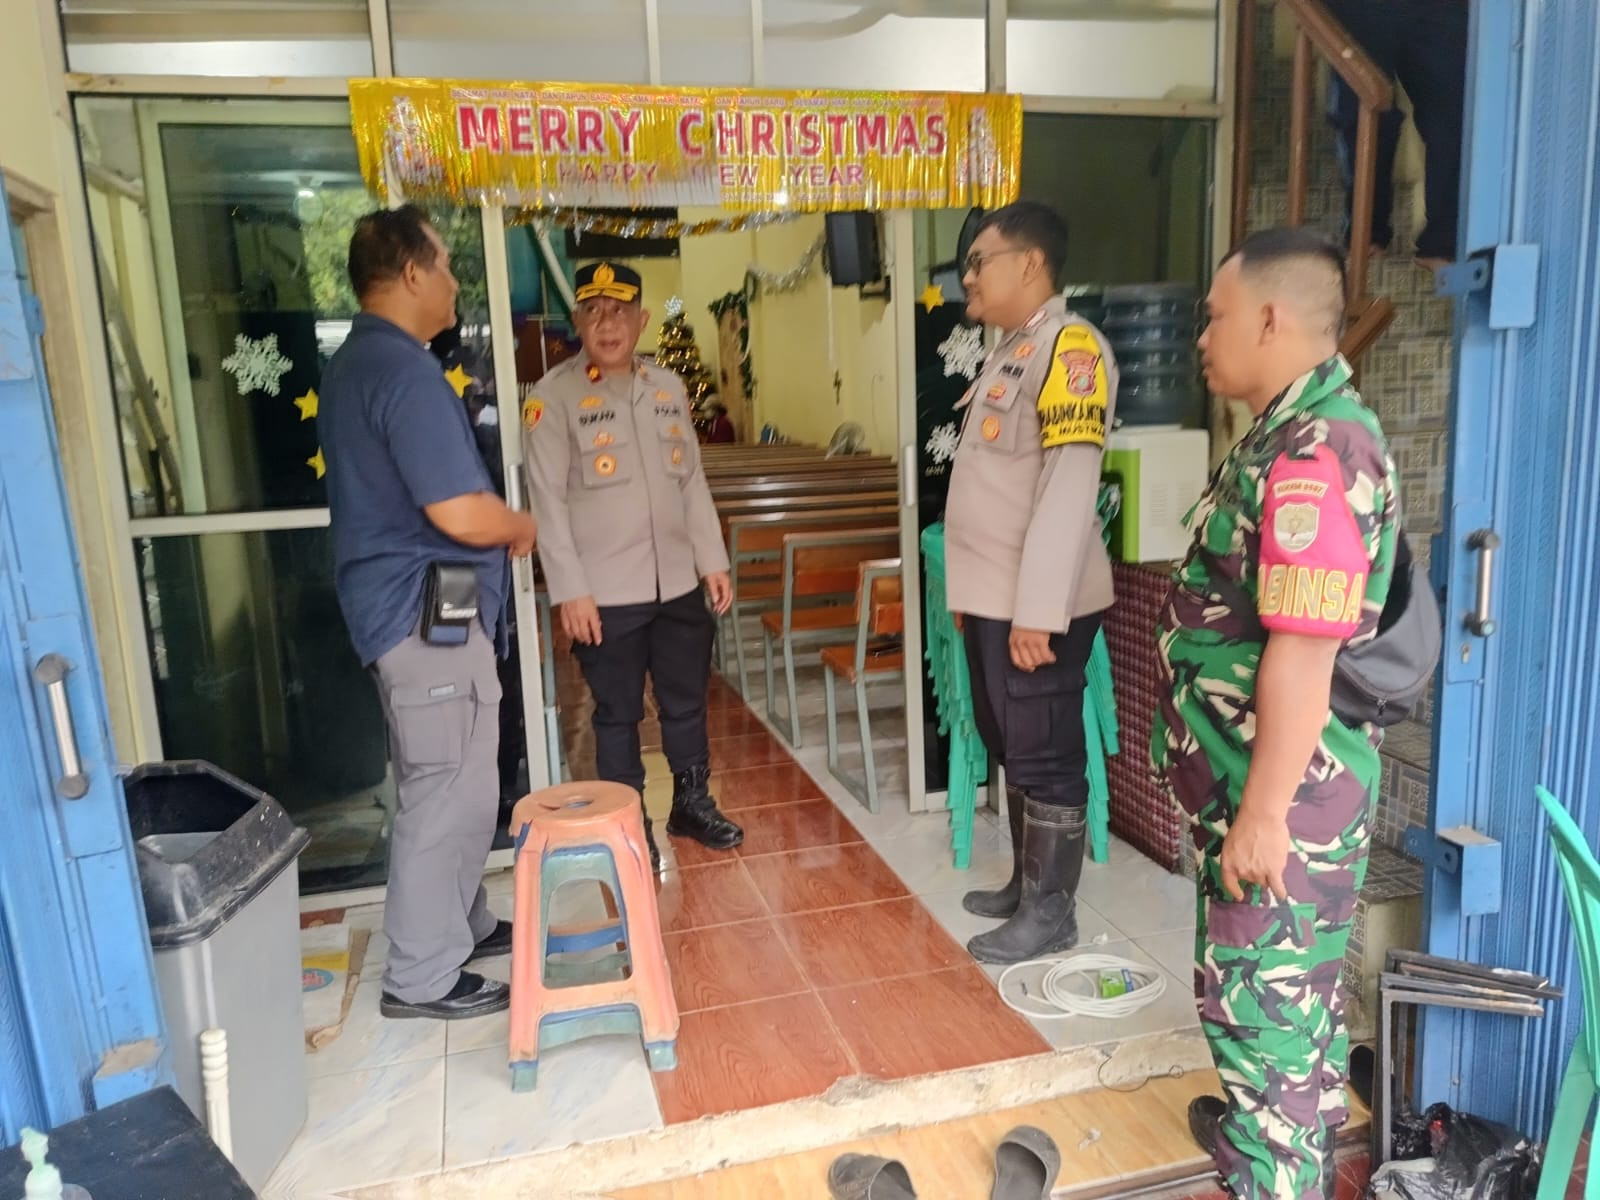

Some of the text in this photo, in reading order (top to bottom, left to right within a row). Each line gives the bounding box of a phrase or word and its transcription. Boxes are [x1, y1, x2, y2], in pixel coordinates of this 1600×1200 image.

[457, 104, 947, 158] MERRY CHRISTMAS
[558, 161, 659, 185] HAPPY
[788, 164, 866, 187] YEAR
